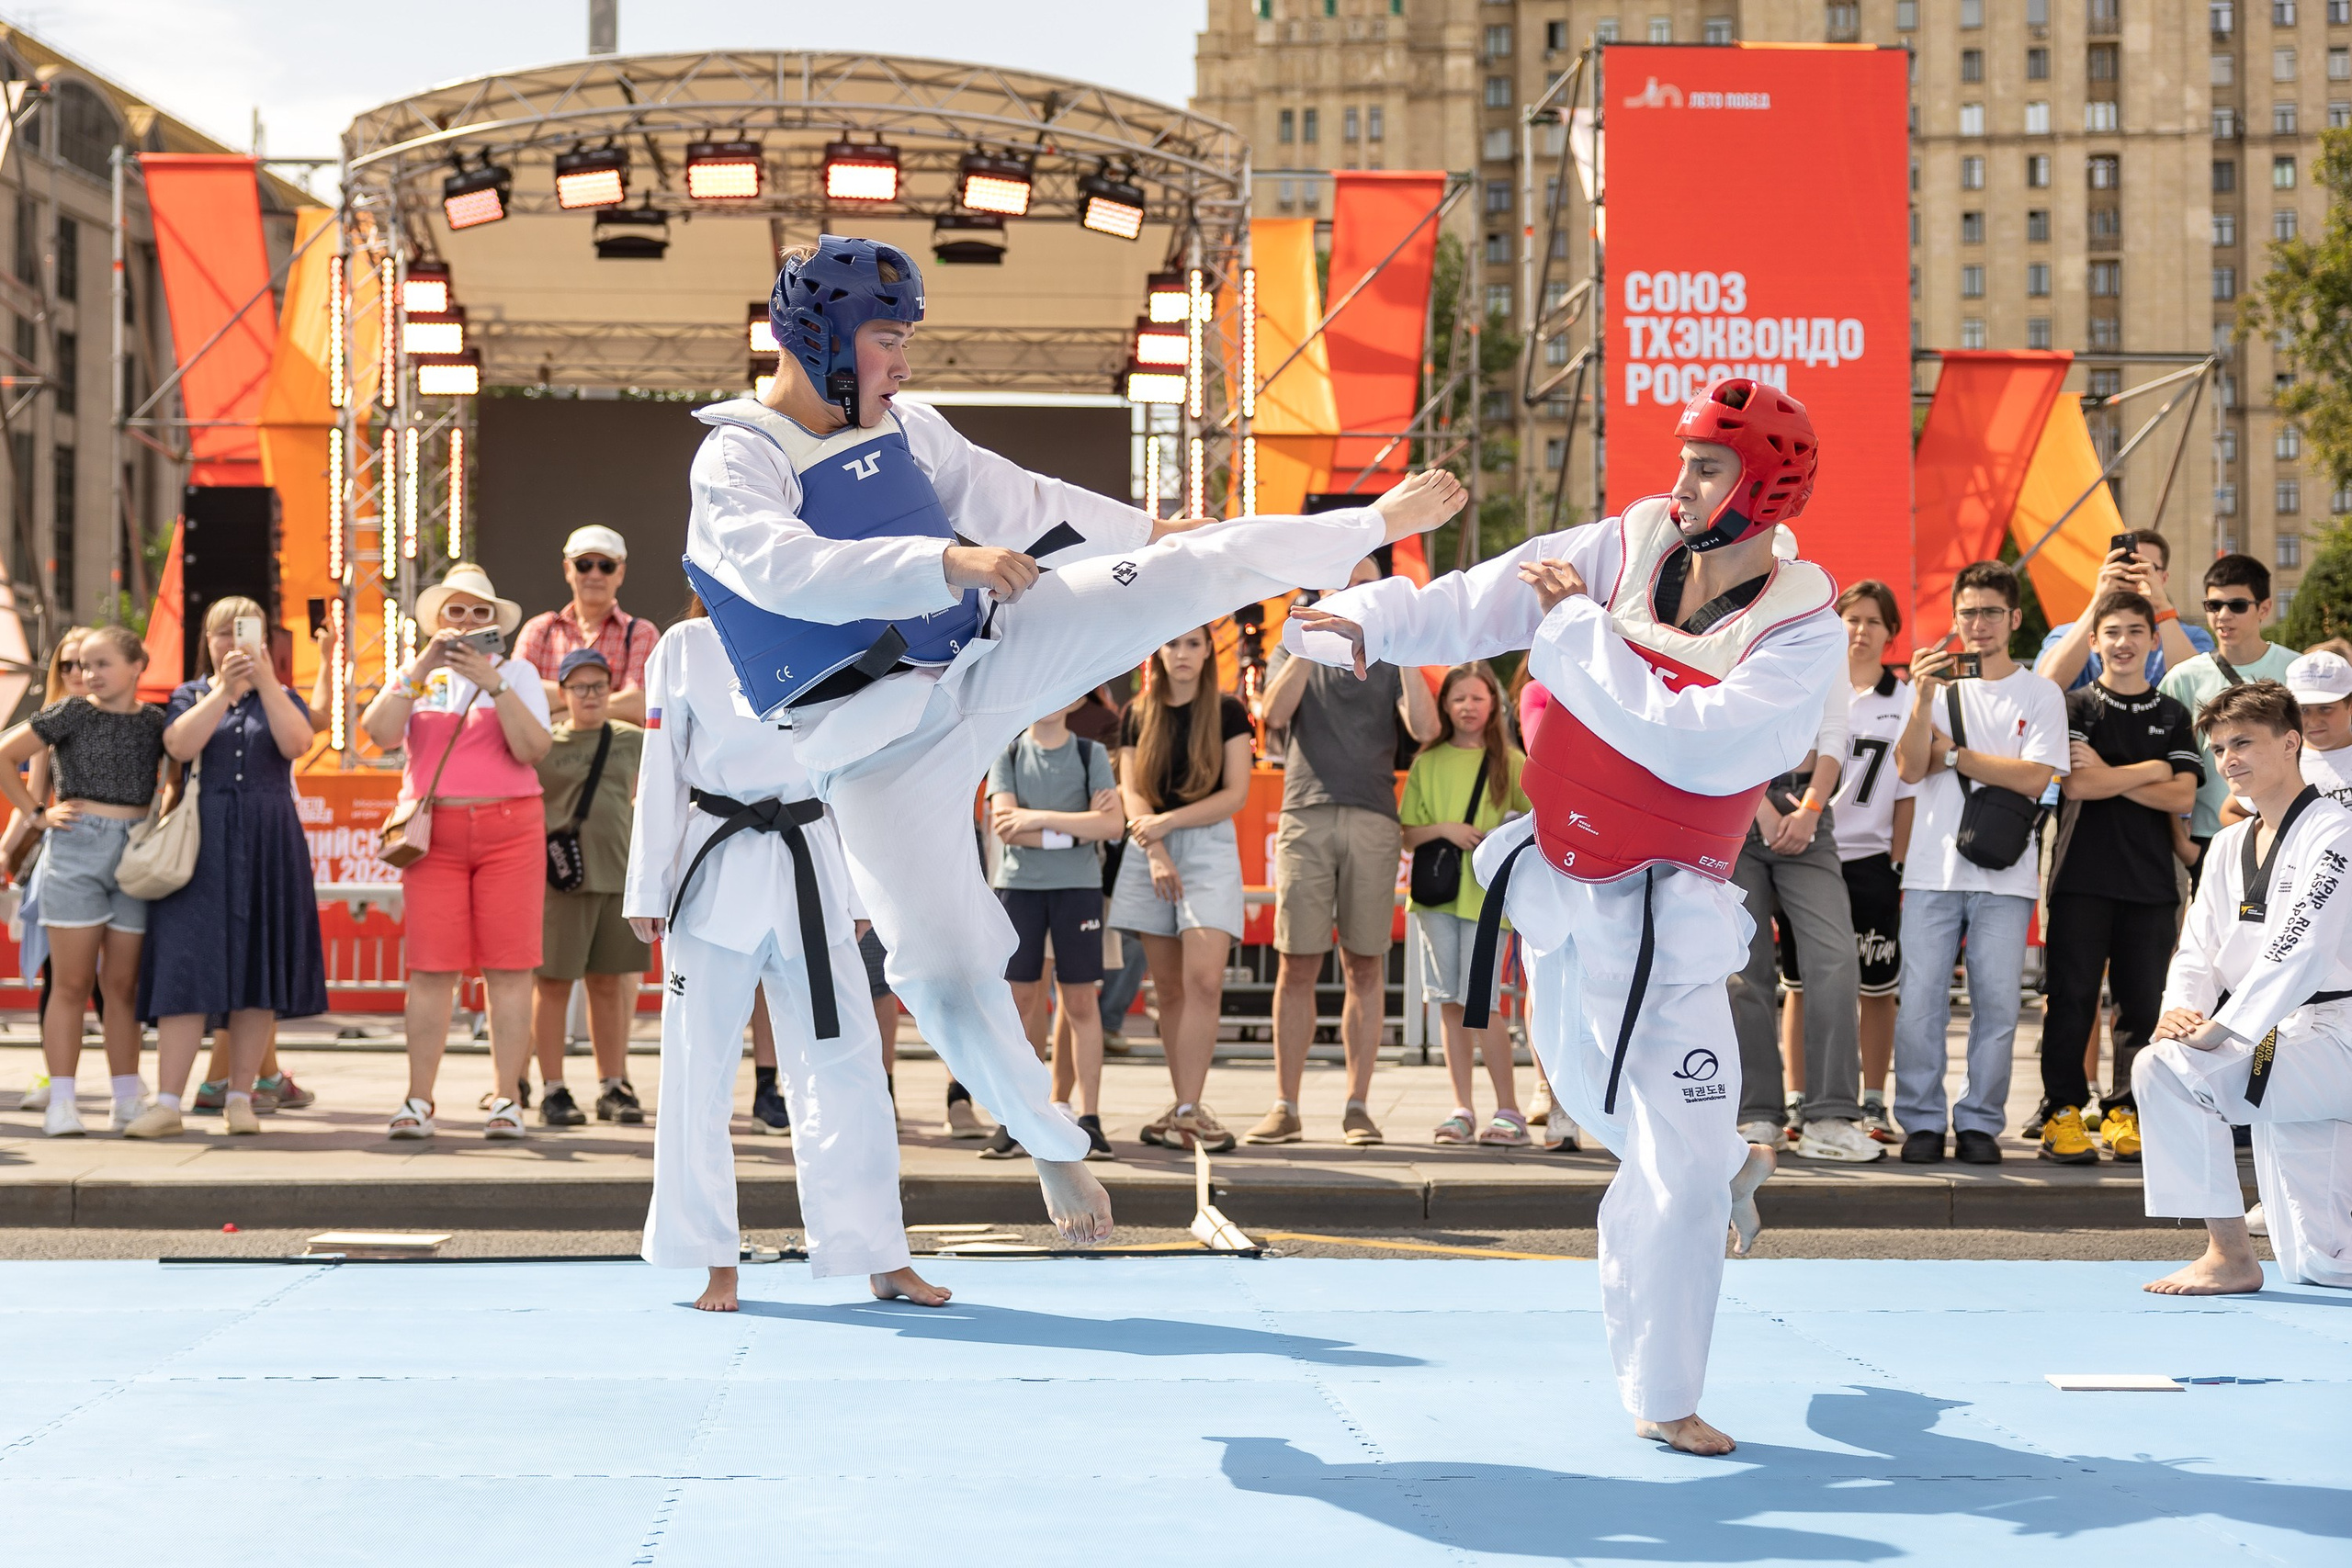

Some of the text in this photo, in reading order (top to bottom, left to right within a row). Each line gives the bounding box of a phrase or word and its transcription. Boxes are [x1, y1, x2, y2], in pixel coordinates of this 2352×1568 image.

[1689, 92, 1771, 109] ЛЕТО ПОБЕД
[1624, 270, 1747, 313] СОЮЗ
[1624, 317, 1865, 368] ТХЭКВОНДО
[949, 639, 960, 655] 3
[776, 665, 794, 682] CE
[1563, 851, 1576, 867] 3
[2311, 875, 2339, 910] KPNP
[2270, 917, 2311, 963] RUSSIA
[1681, 1083, 1726, 1098] 태권도원
